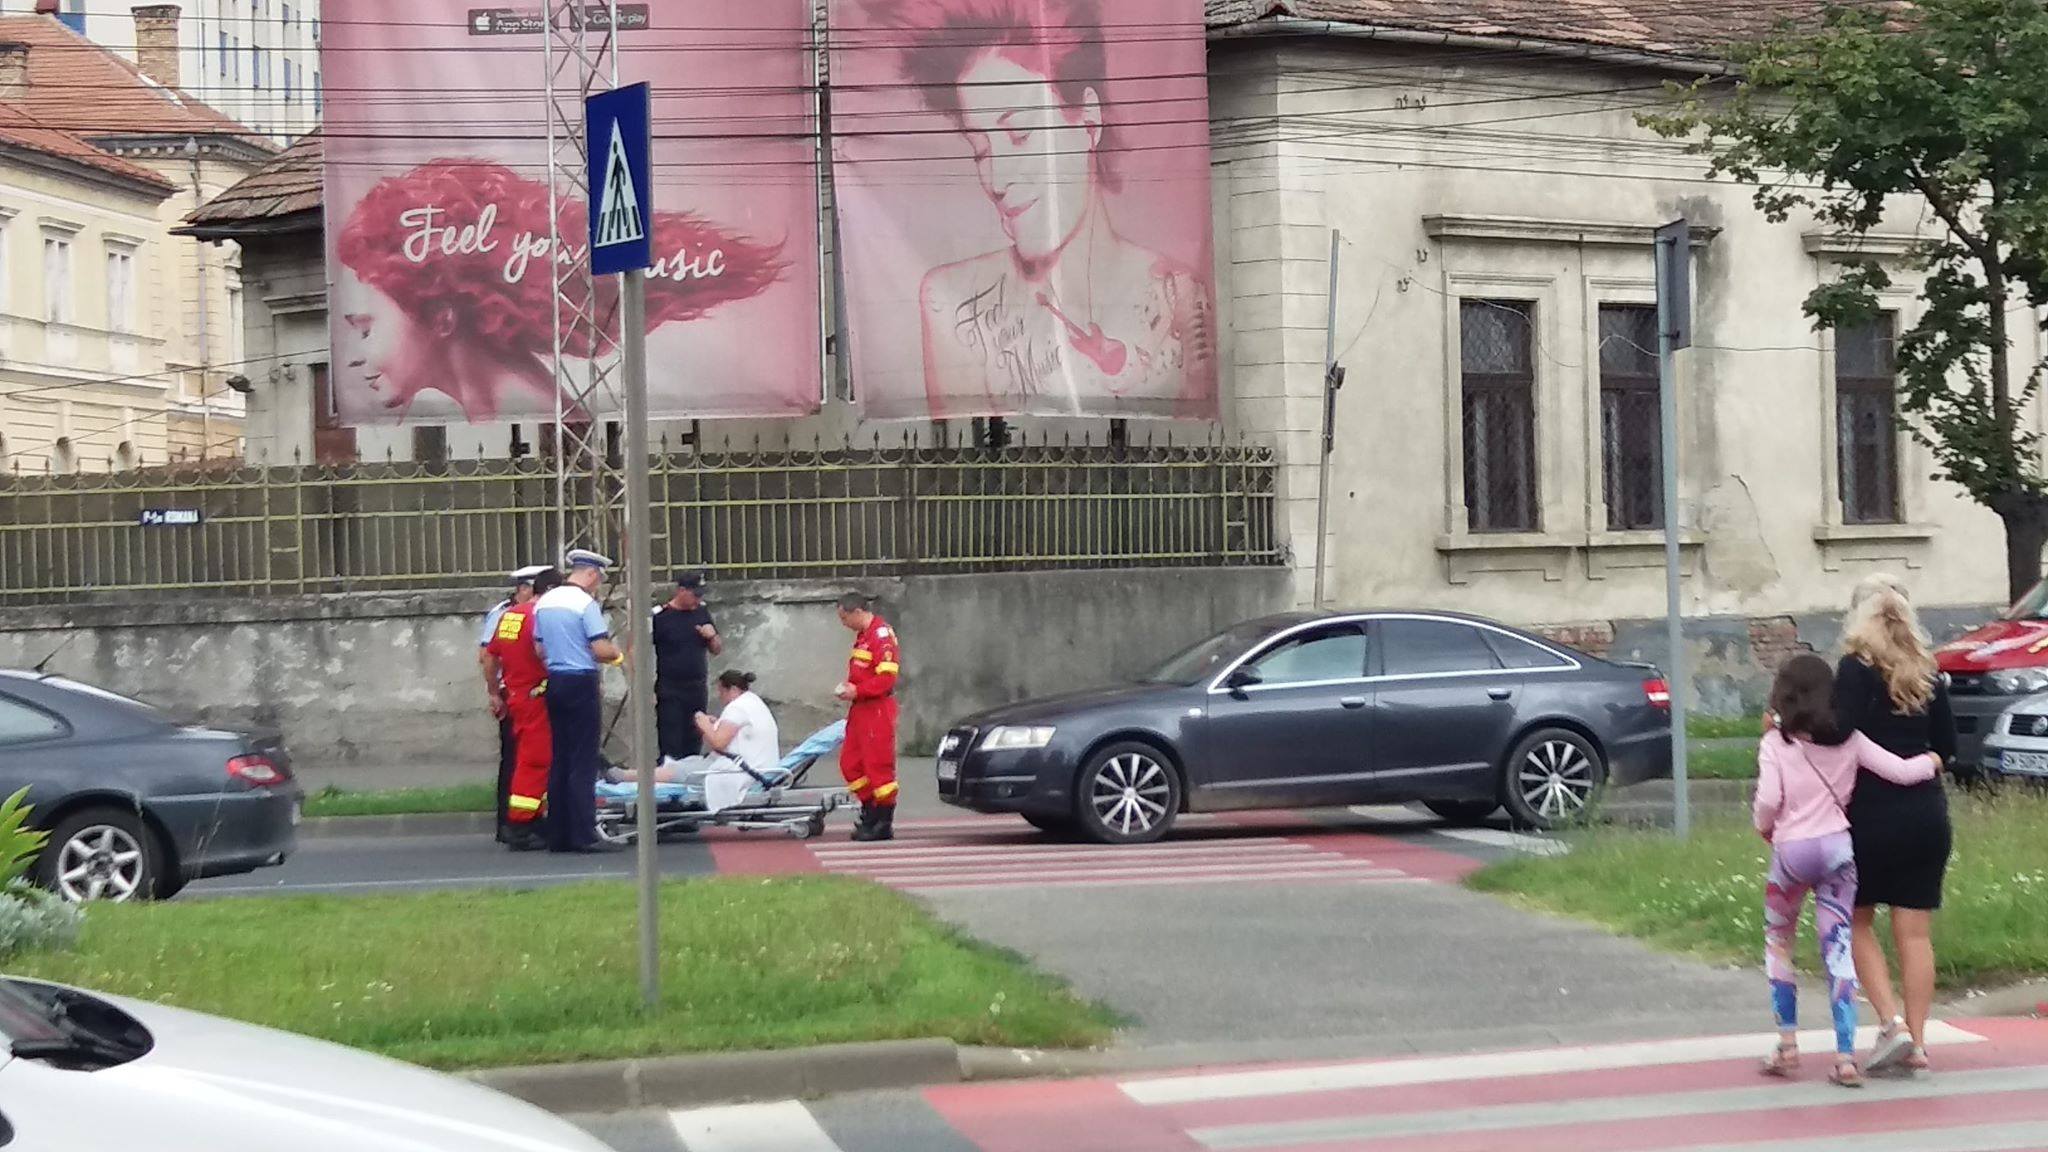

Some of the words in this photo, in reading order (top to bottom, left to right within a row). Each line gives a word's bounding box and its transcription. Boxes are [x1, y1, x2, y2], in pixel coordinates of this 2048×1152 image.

[521, 19, 546, 30] Stor
[592, 14, 625, 25] Goole
[400, 203, 499, 262] Feel
[644, 242, 726, 281] usic
